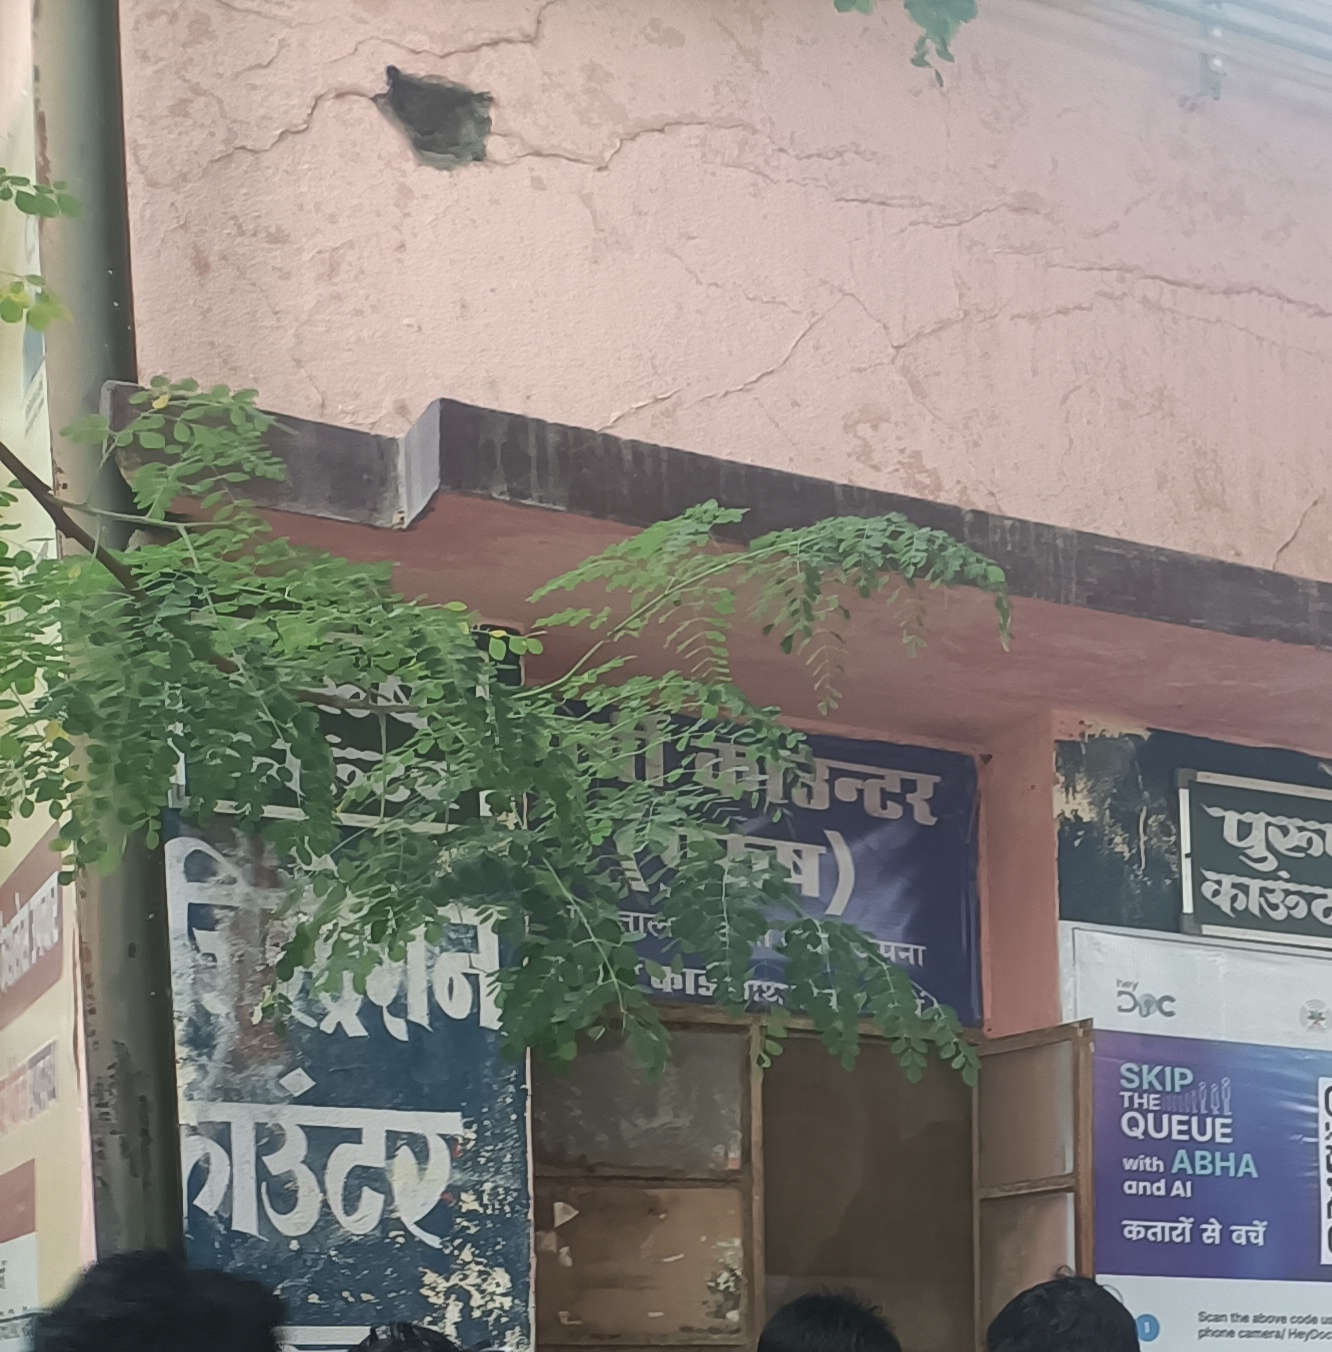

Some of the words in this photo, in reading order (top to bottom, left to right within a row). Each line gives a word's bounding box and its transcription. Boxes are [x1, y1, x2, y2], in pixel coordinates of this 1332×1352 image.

[1119, 1062, 1194, 1092] SKIP
[1119, 1092, 1161, 1110] THE
[1121, 1112, 1233, 1143] QUEUE
[1123, 1156, 1164, 1173] with
[1171, 1149, 1258, 1178] ABHA
[1124, 1179, 1166, 1196] and
[1170, 1181, 1192, 1197] AI
[1122, 1216, 1195, 1243] कतारों
[1200, 1217, 1222, 1244] से
[1198, 1311, 1227, 1323] Scan
[1230, 1312, 1249, 1323] the
[1252, 1313, 1287, 1324] above
[1290, 1314, 1318, 1325] code
[1198, 1327, 1235, 1341] phone
[1288, 1328, 1332, 1342] HeyDoc
